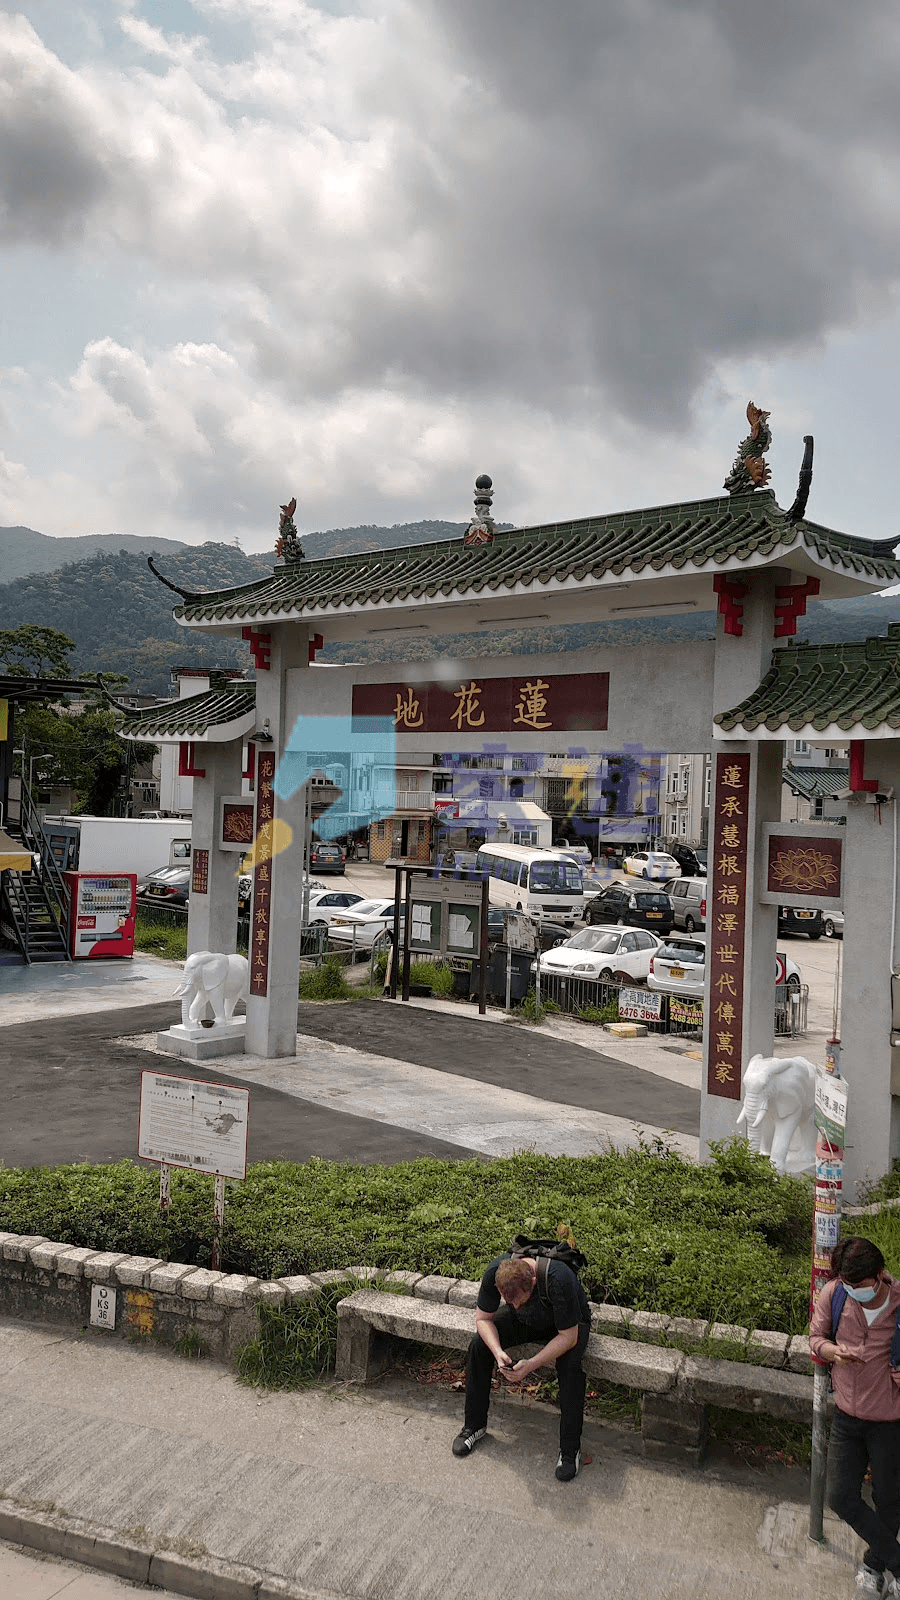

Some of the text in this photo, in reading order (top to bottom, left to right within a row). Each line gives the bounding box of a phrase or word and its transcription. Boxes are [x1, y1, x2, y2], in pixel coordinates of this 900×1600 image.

[253, 760, 273, 989] 花繁族茂景盛千秋享太平
[714, 765, 745, 1084] 蓮承慧根福澤世代傳萬家
[619, 1007, 639, 1017] 2476
[98, 1299, 109, 1309] KS
[98, 1310, 107, 1319] 36
